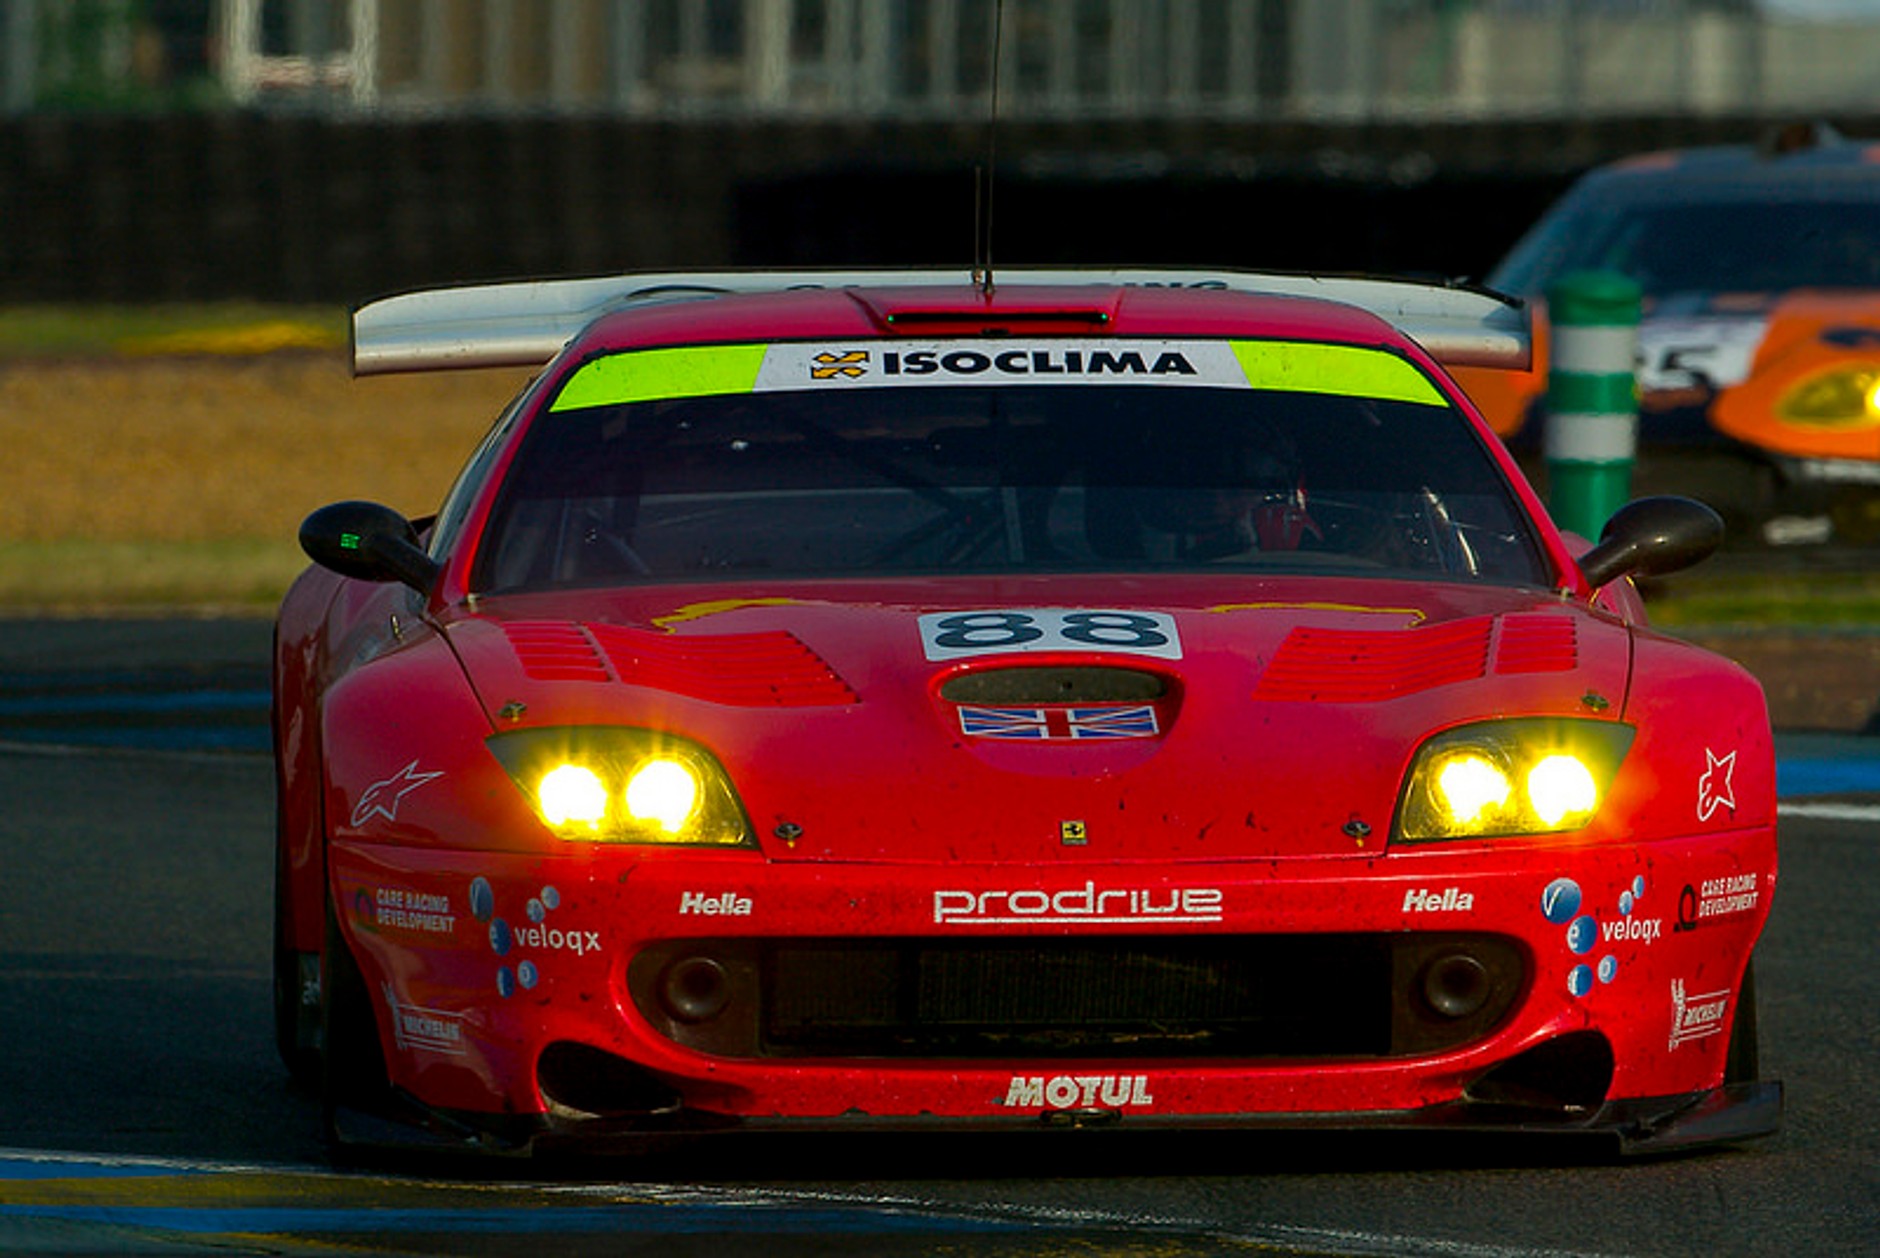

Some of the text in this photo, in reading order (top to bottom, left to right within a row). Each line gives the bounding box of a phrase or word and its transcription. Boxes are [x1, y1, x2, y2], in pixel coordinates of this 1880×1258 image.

[882, 350, 1197, 375] ISOCLIMA
[935, 613, 1168, 648] 88
[1700, 873, 1757, 898] CARE RACING
[376, 888, 449, 913] CARE RACING
[679, 891, 753, 915] Hella
[934, 880, 1223, 924] prodrive
[1402, 887, 1474, 912] Hella
[1699, 891, 1759, 918] DEVELOPMENT
[377, 908, 455, 932] DEVELOPMENT
[1601, 915, 1661, 945] veloqx
[514, 923, 602, 956] veloqx
[1682, 999, 1727, 1027] MICHELIN
[402, 1015, 461, 1040] MICHELIN
[1003, 1075, 1153, 1108] MOTUL
